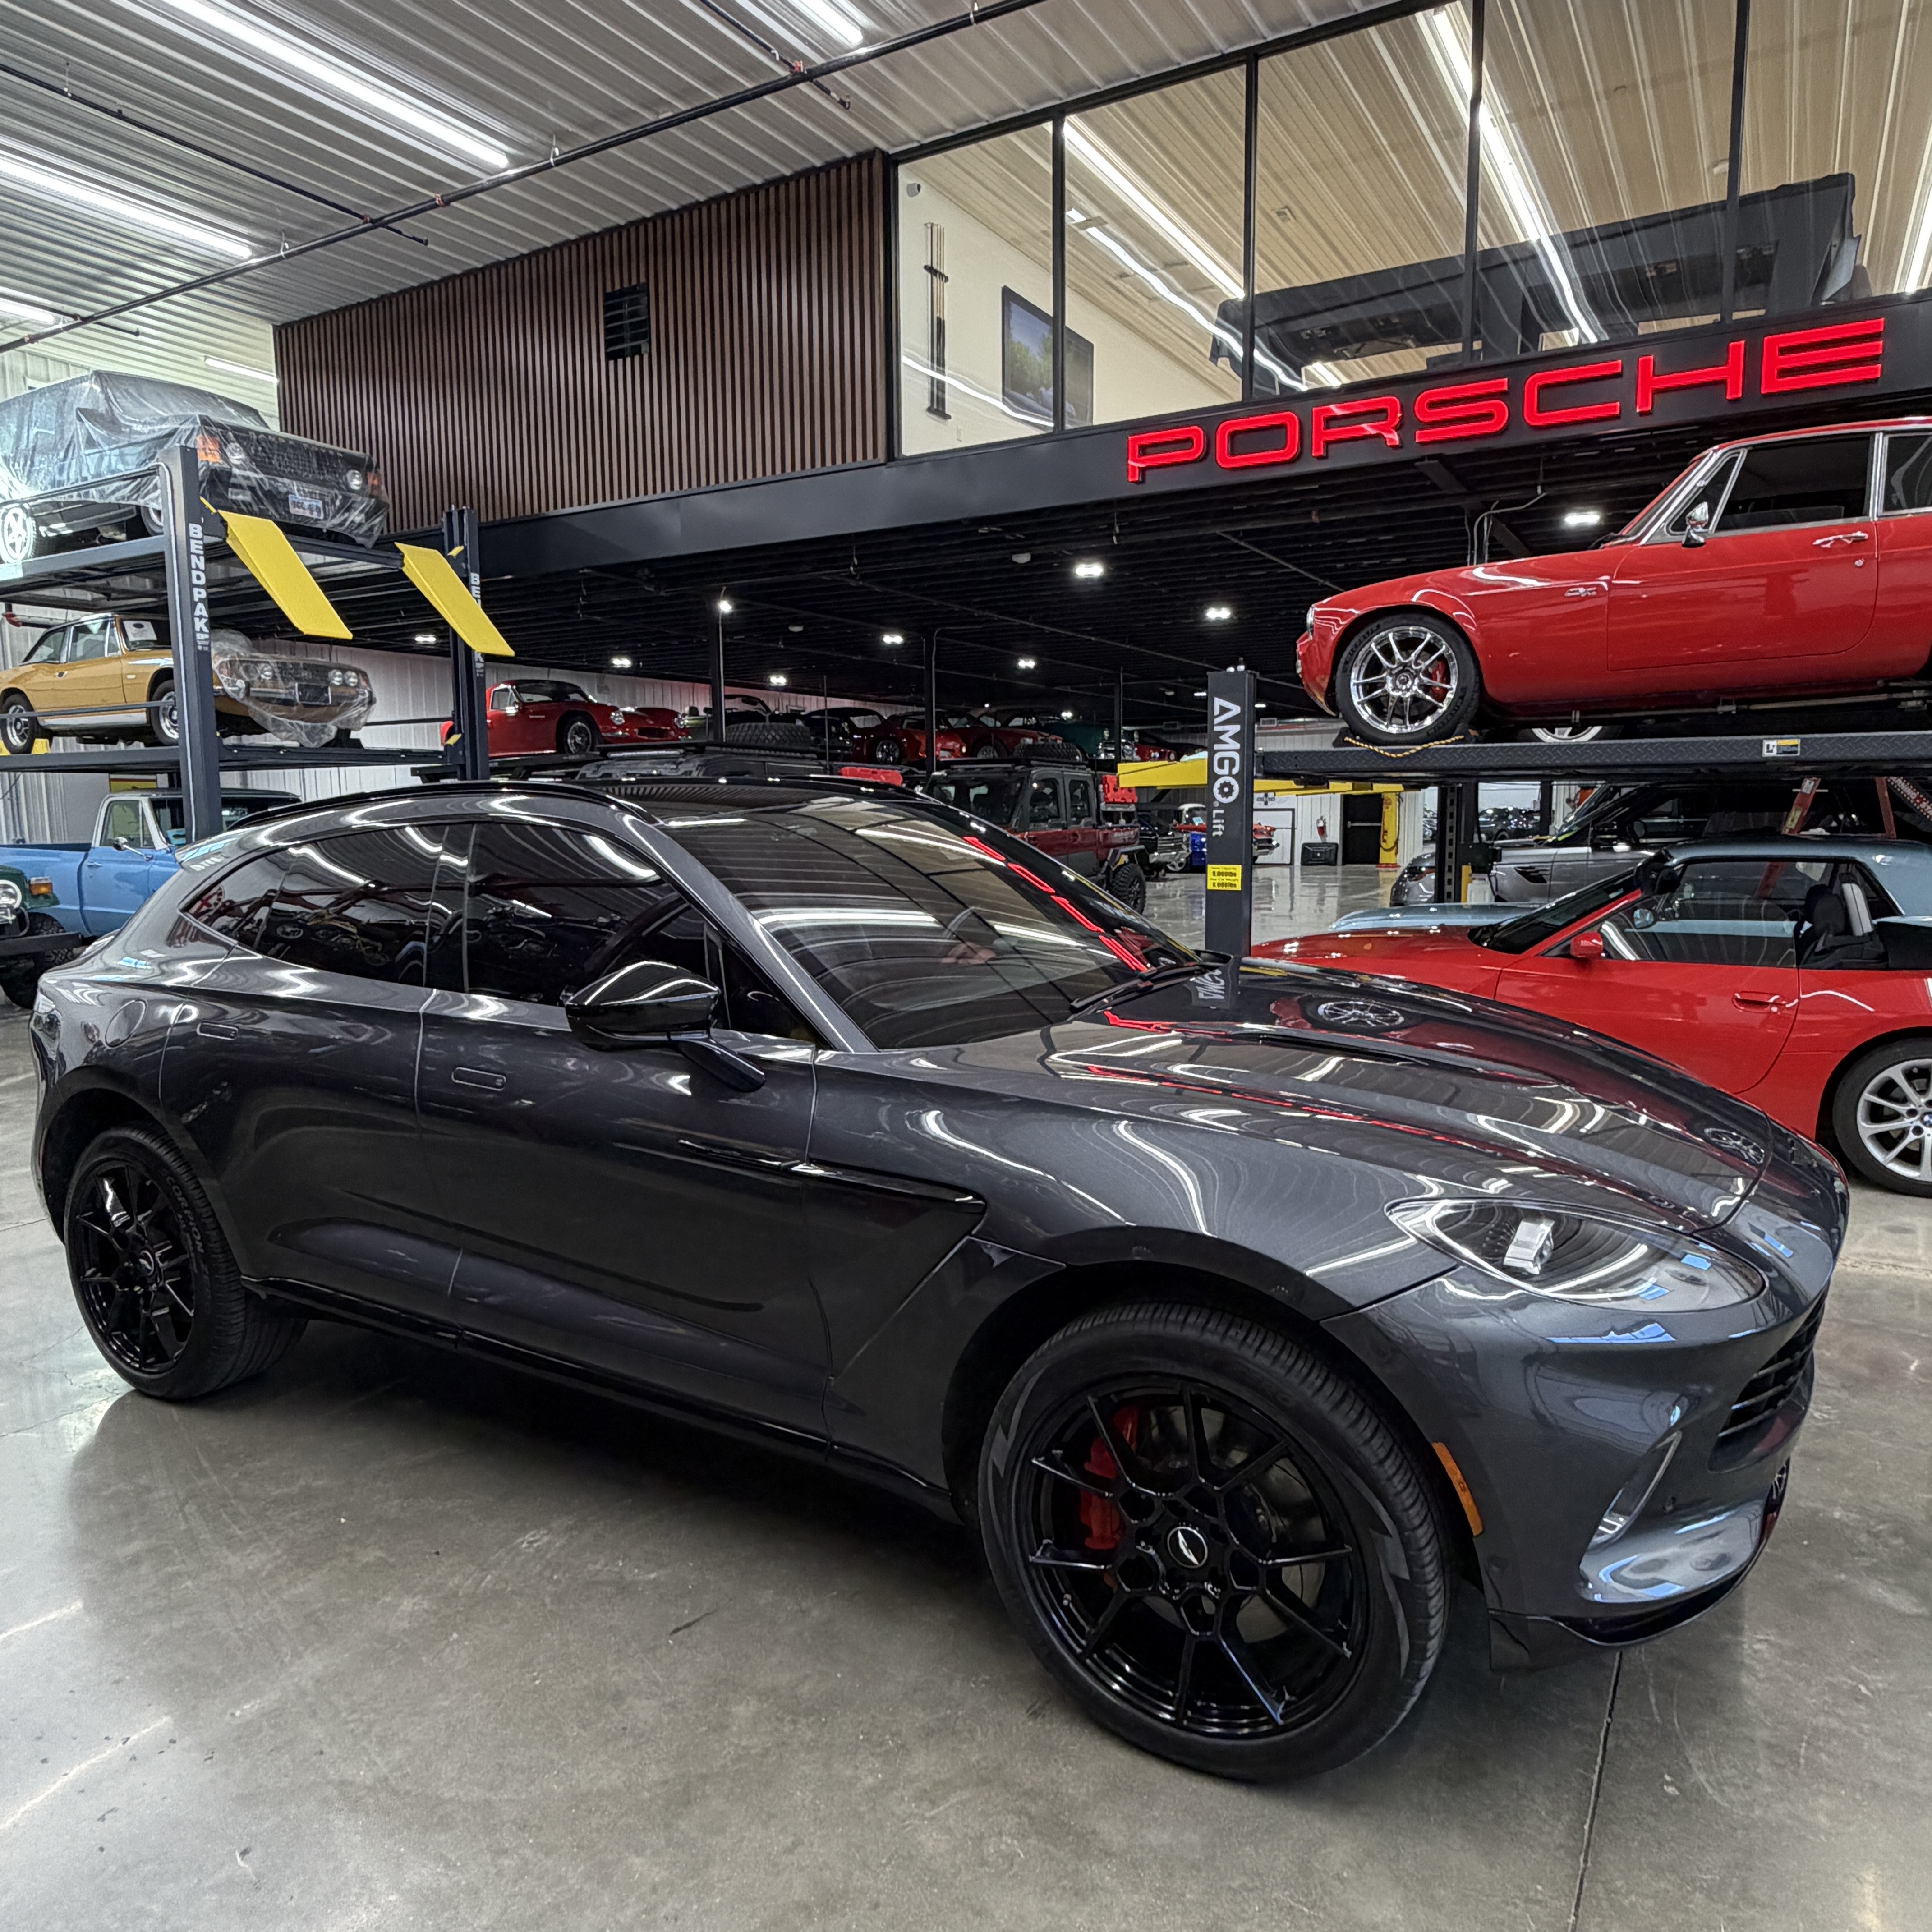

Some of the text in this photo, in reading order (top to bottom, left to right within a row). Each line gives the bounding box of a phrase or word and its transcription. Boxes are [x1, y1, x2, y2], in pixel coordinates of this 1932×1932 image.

[1127, 317, 1885, 483] PORSCHE
[189, 523, 209, 632] BENDPAK
[1212, 697, 1241, 837] AMGO Lift
